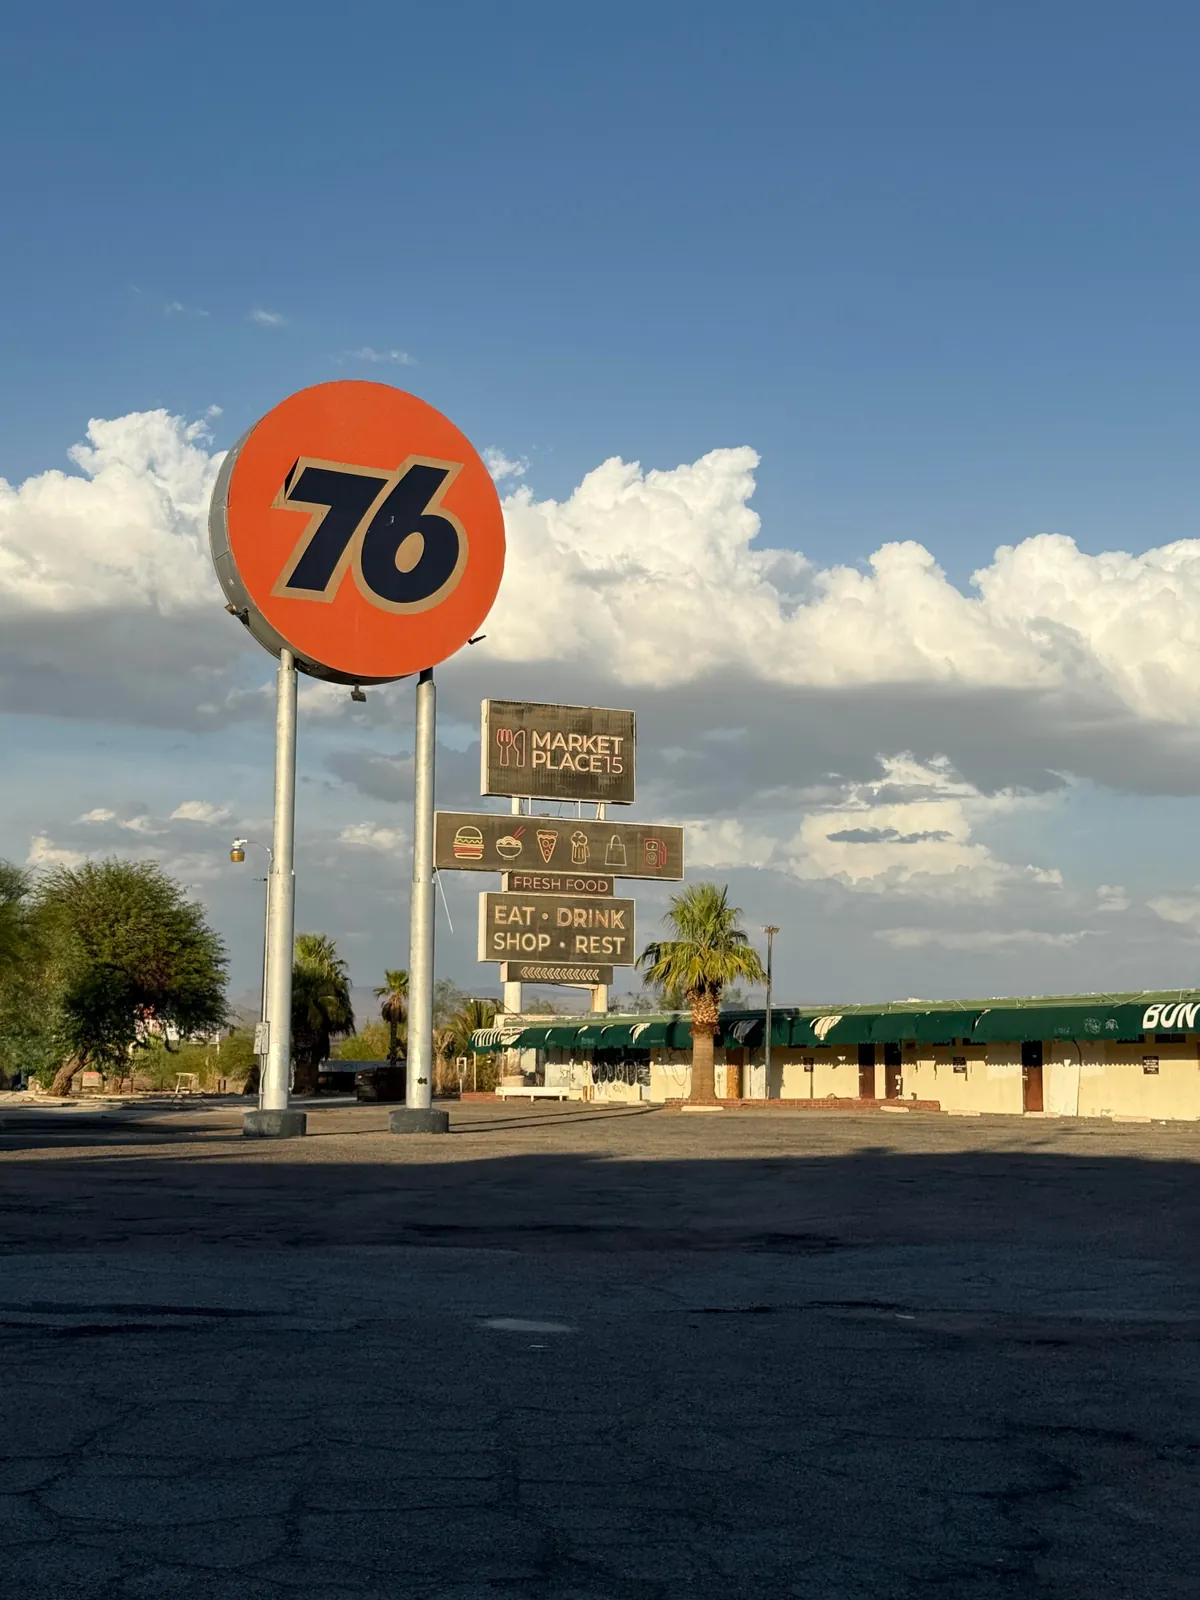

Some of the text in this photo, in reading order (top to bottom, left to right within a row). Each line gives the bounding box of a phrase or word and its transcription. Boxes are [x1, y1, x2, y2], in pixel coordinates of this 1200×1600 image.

[273, 456, 467, 612] 76
[532, 730, 624, 755] MARKET
[532, 750, 624, 774] PLACE15
[513, 876, 609, 893] FRESH FOOD
[494, 905, 625, 930] EAT DRINK
[493, 932, 626, 955] SHOP REST
[1142, 1002, 1200, 1029] BUN
